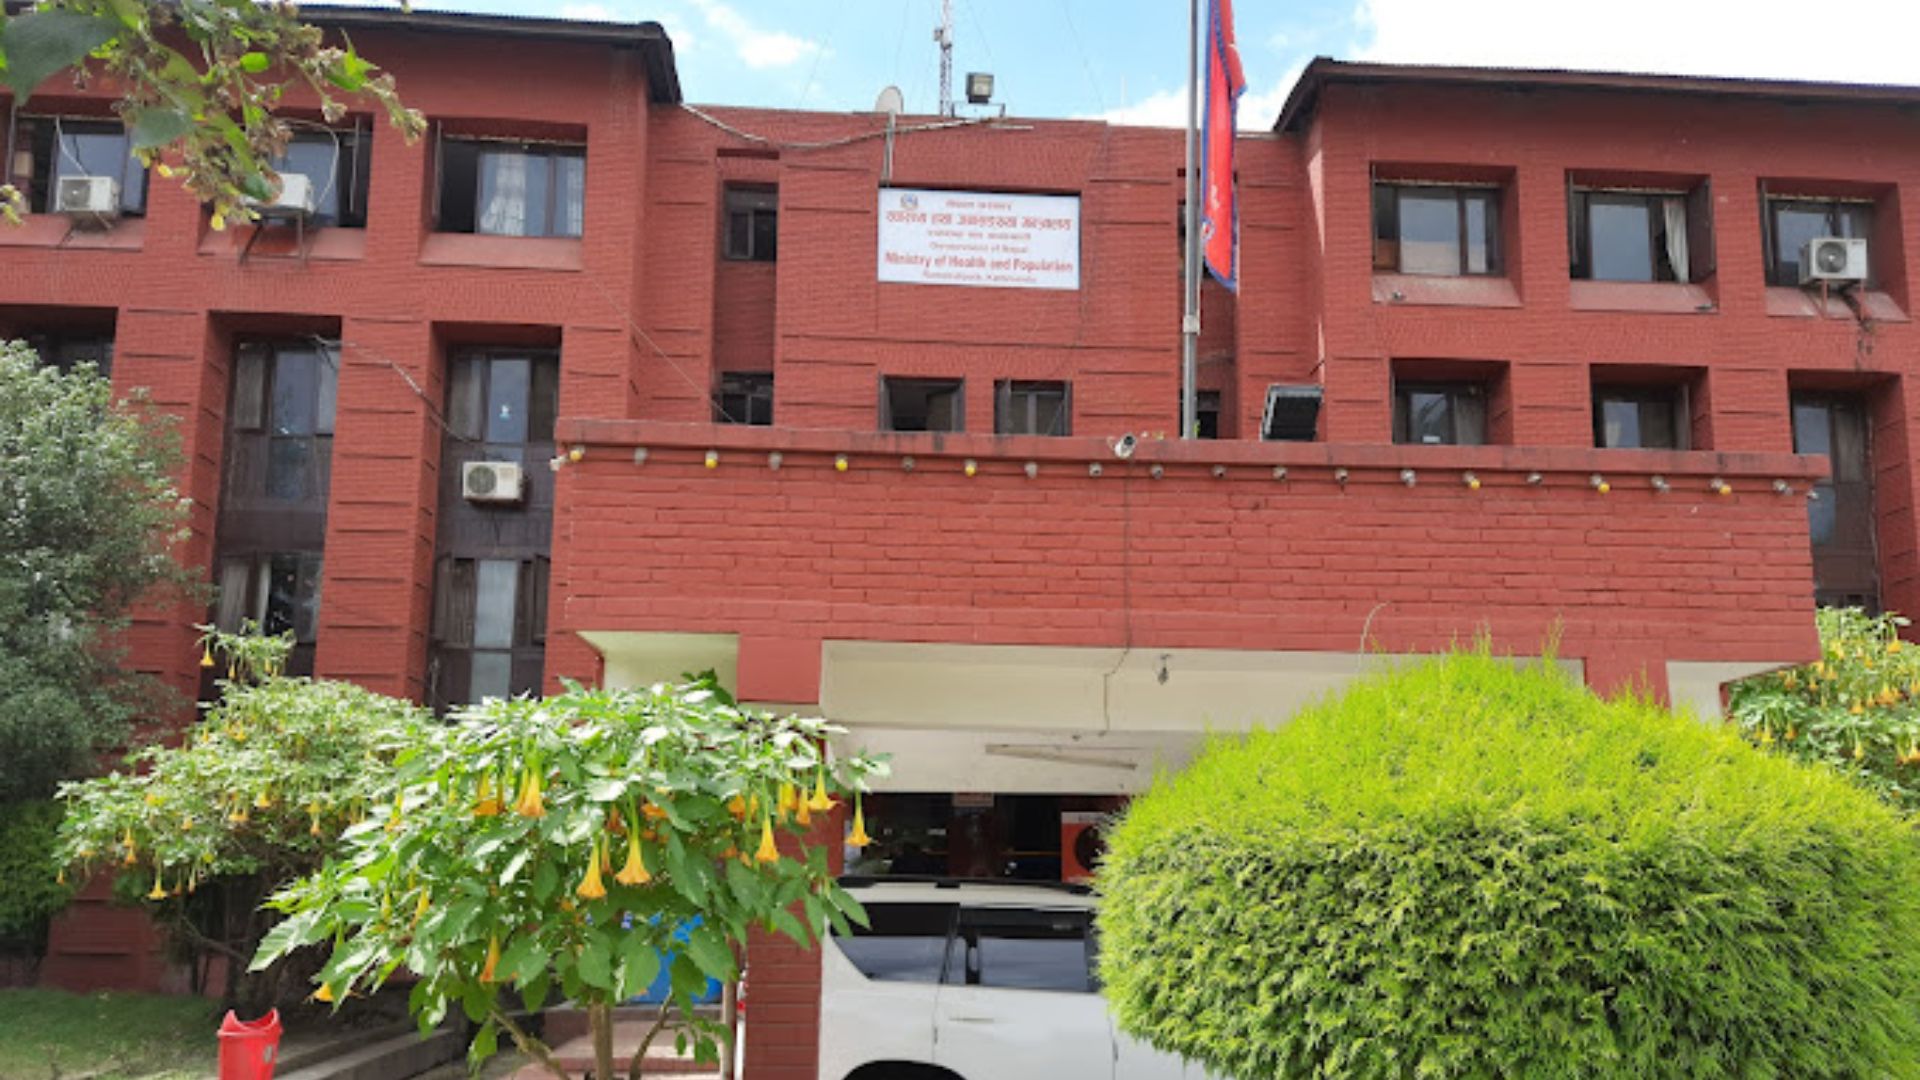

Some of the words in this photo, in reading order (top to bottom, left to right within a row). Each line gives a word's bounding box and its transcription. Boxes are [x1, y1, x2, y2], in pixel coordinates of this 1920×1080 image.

[884, 251, 932, 268] Ministry
[935, 255, 947, 266] of
[948, 255, 986, 268] Health
[990, 258, 1012, 270] and
[1013, 258, 1073, 273] Population
